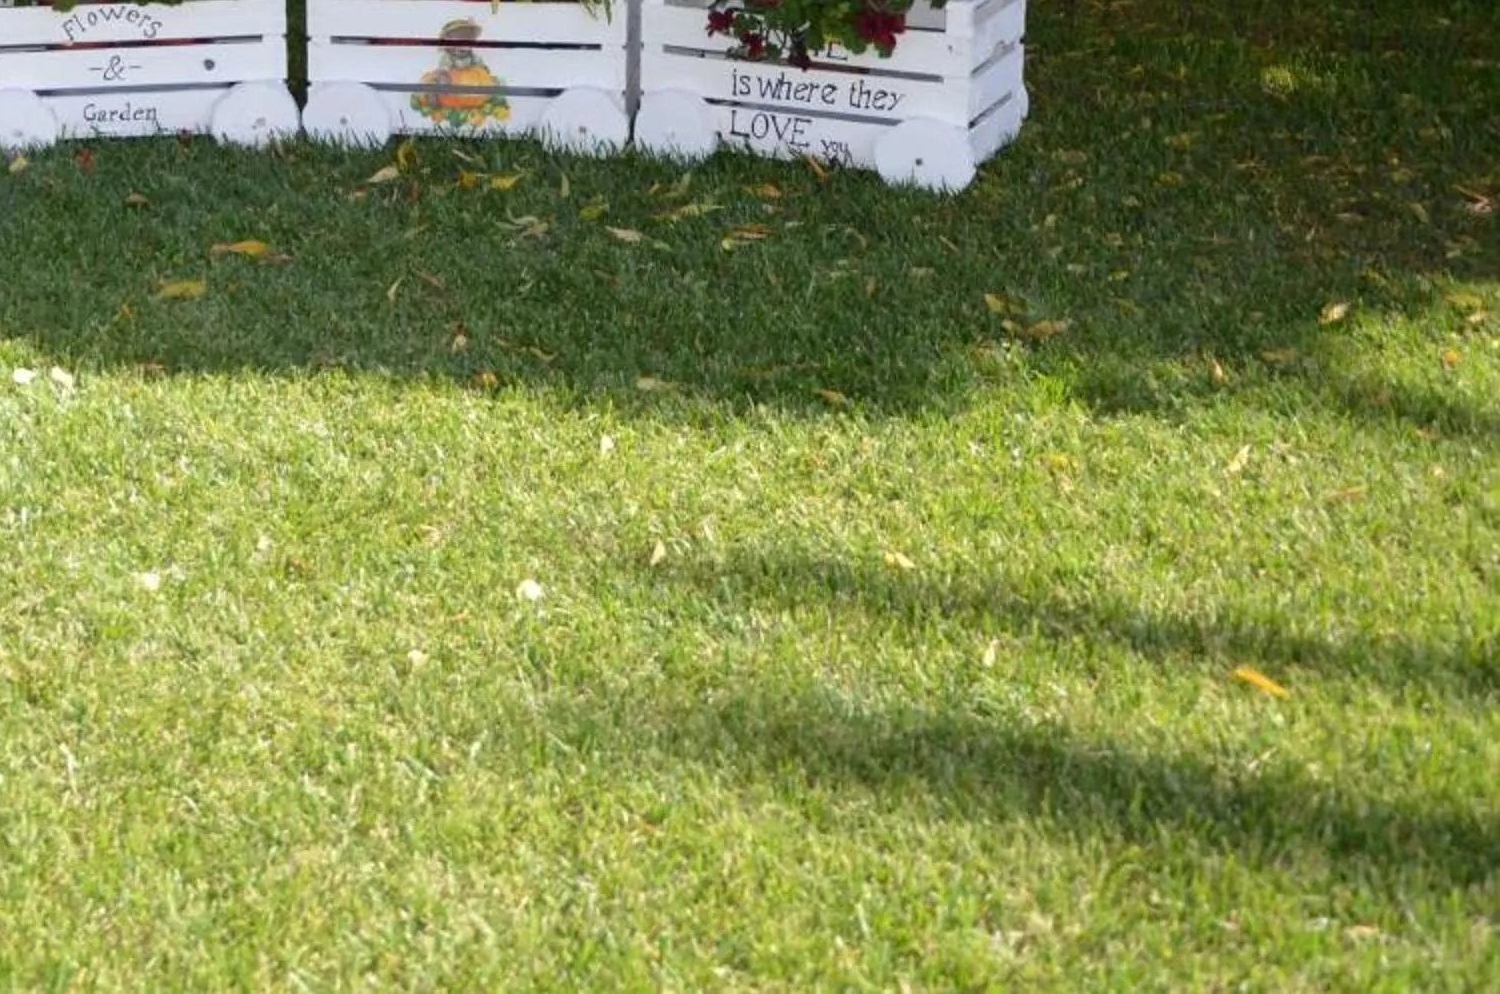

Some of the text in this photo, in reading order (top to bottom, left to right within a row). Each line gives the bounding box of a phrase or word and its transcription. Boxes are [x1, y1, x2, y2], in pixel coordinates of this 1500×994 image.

[62, 6, 163, 41] Flowers
[732, 69, 906, 111] is where they
[83, 102, 157, 122] Garden
[730, 109, 812, 147] LOVE
